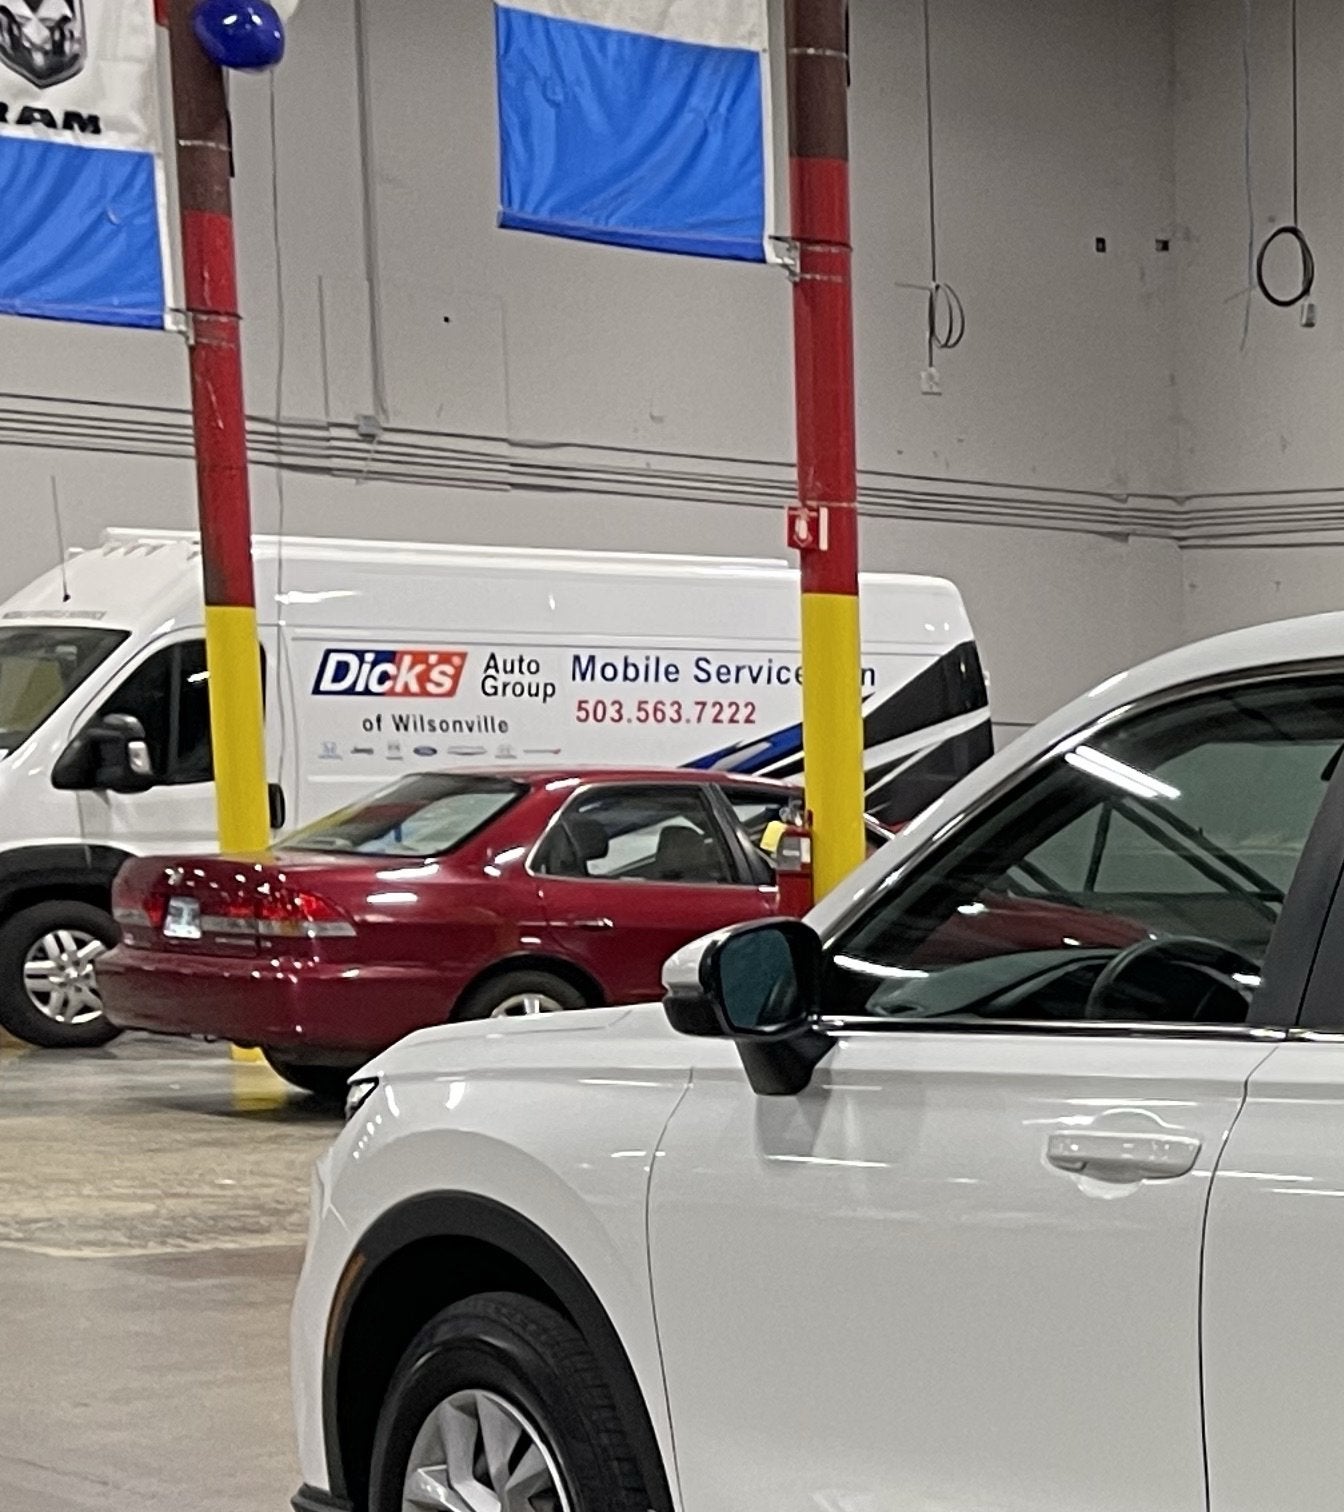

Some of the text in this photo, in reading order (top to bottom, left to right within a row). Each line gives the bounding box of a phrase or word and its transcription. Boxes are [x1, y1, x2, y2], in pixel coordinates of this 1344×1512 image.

[0, 102, 102, 134] AM
[483, 652, 541, 676] Auto
[571, 654, 680, 684] Mobile
[480, 674, 557, 703] Group
[362, 714, 509, 734] of Wilsonville
[575, 699, 757, 725] 503.563.7222
